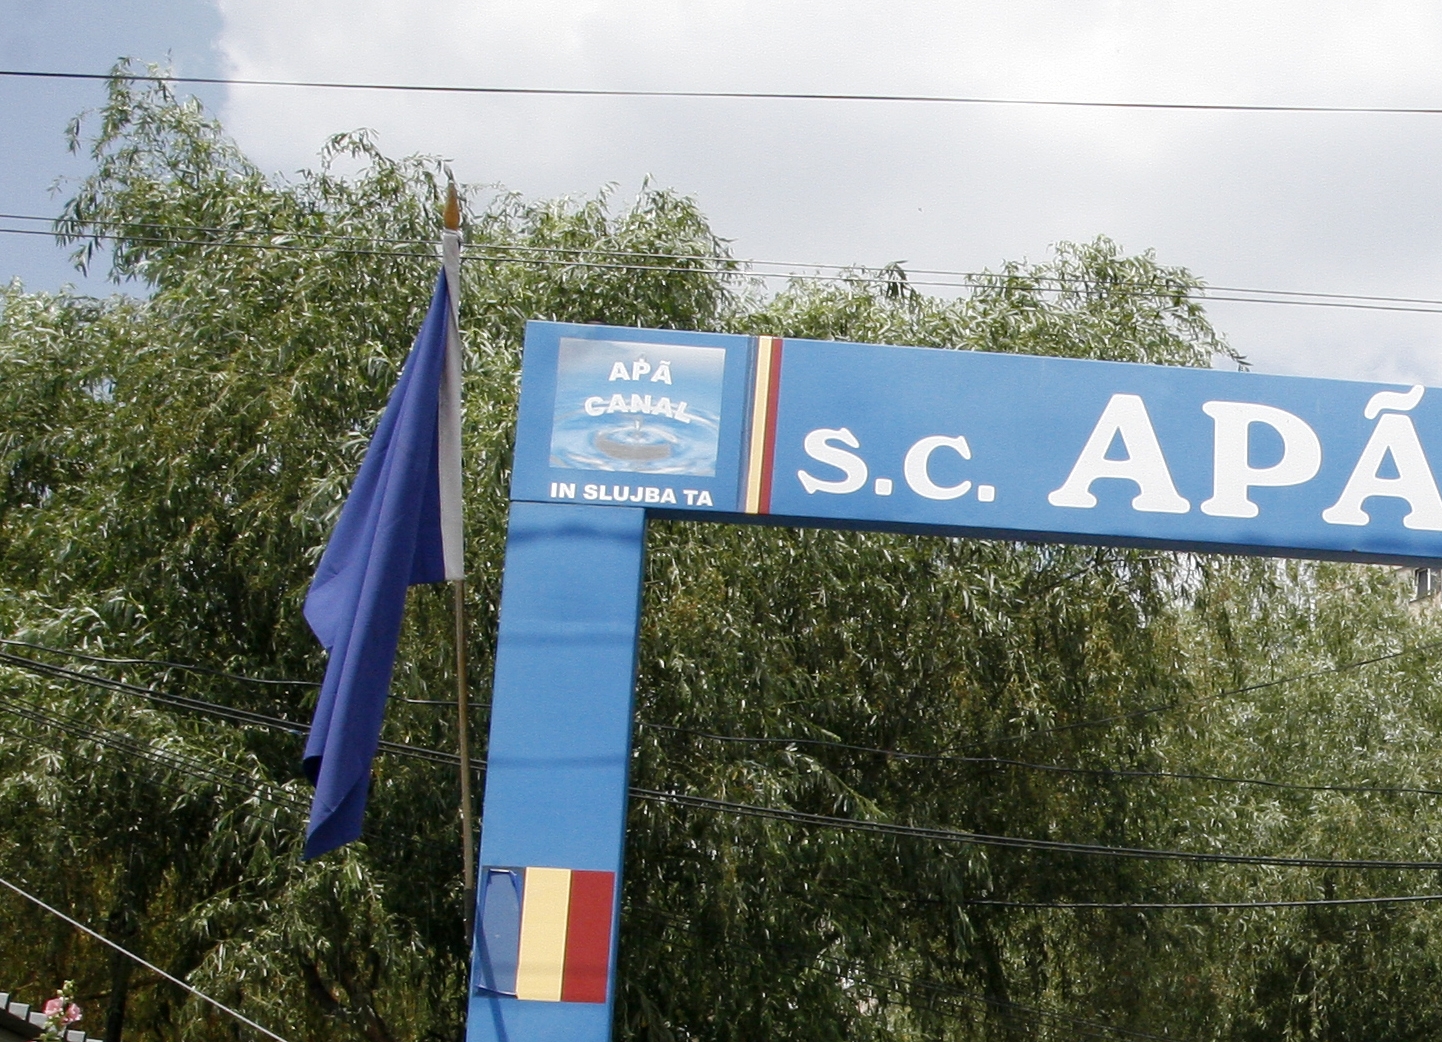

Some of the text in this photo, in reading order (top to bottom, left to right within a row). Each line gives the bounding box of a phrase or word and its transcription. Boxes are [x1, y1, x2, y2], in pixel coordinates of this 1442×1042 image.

[584, 394, 691, 423] CANAL
[798, 428, 995, 502] S.C.
[550, 482, 713, 507] IN SLUJBA TA
